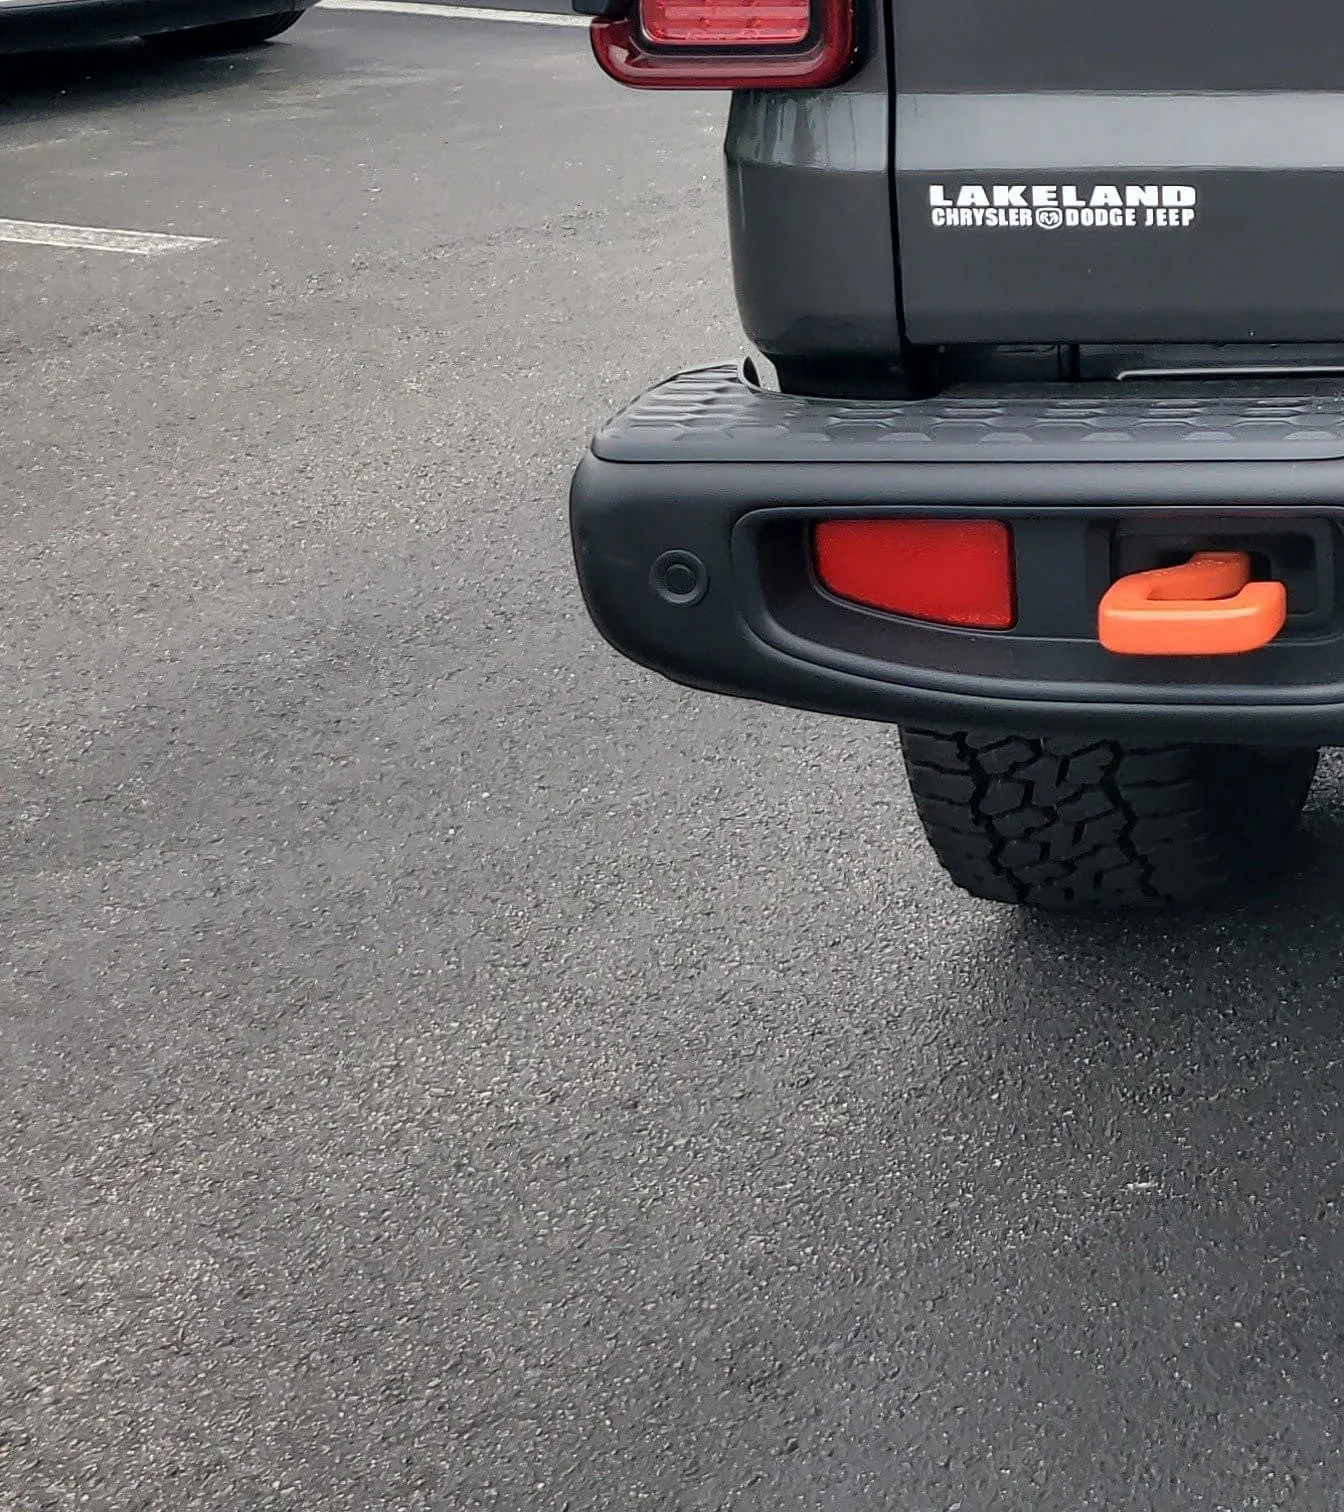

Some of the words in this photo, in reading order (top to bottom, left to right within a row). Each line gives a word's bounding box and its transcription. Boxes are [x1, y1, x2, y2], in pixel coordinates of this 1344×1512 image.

[929, 185, 1196, 206] LAKELAND
[931, 207, 1032, 227] CHRYSLER
[1065, 208, 1136, 226] DODGE
[1145, 208, 1194, 226] JEEP
